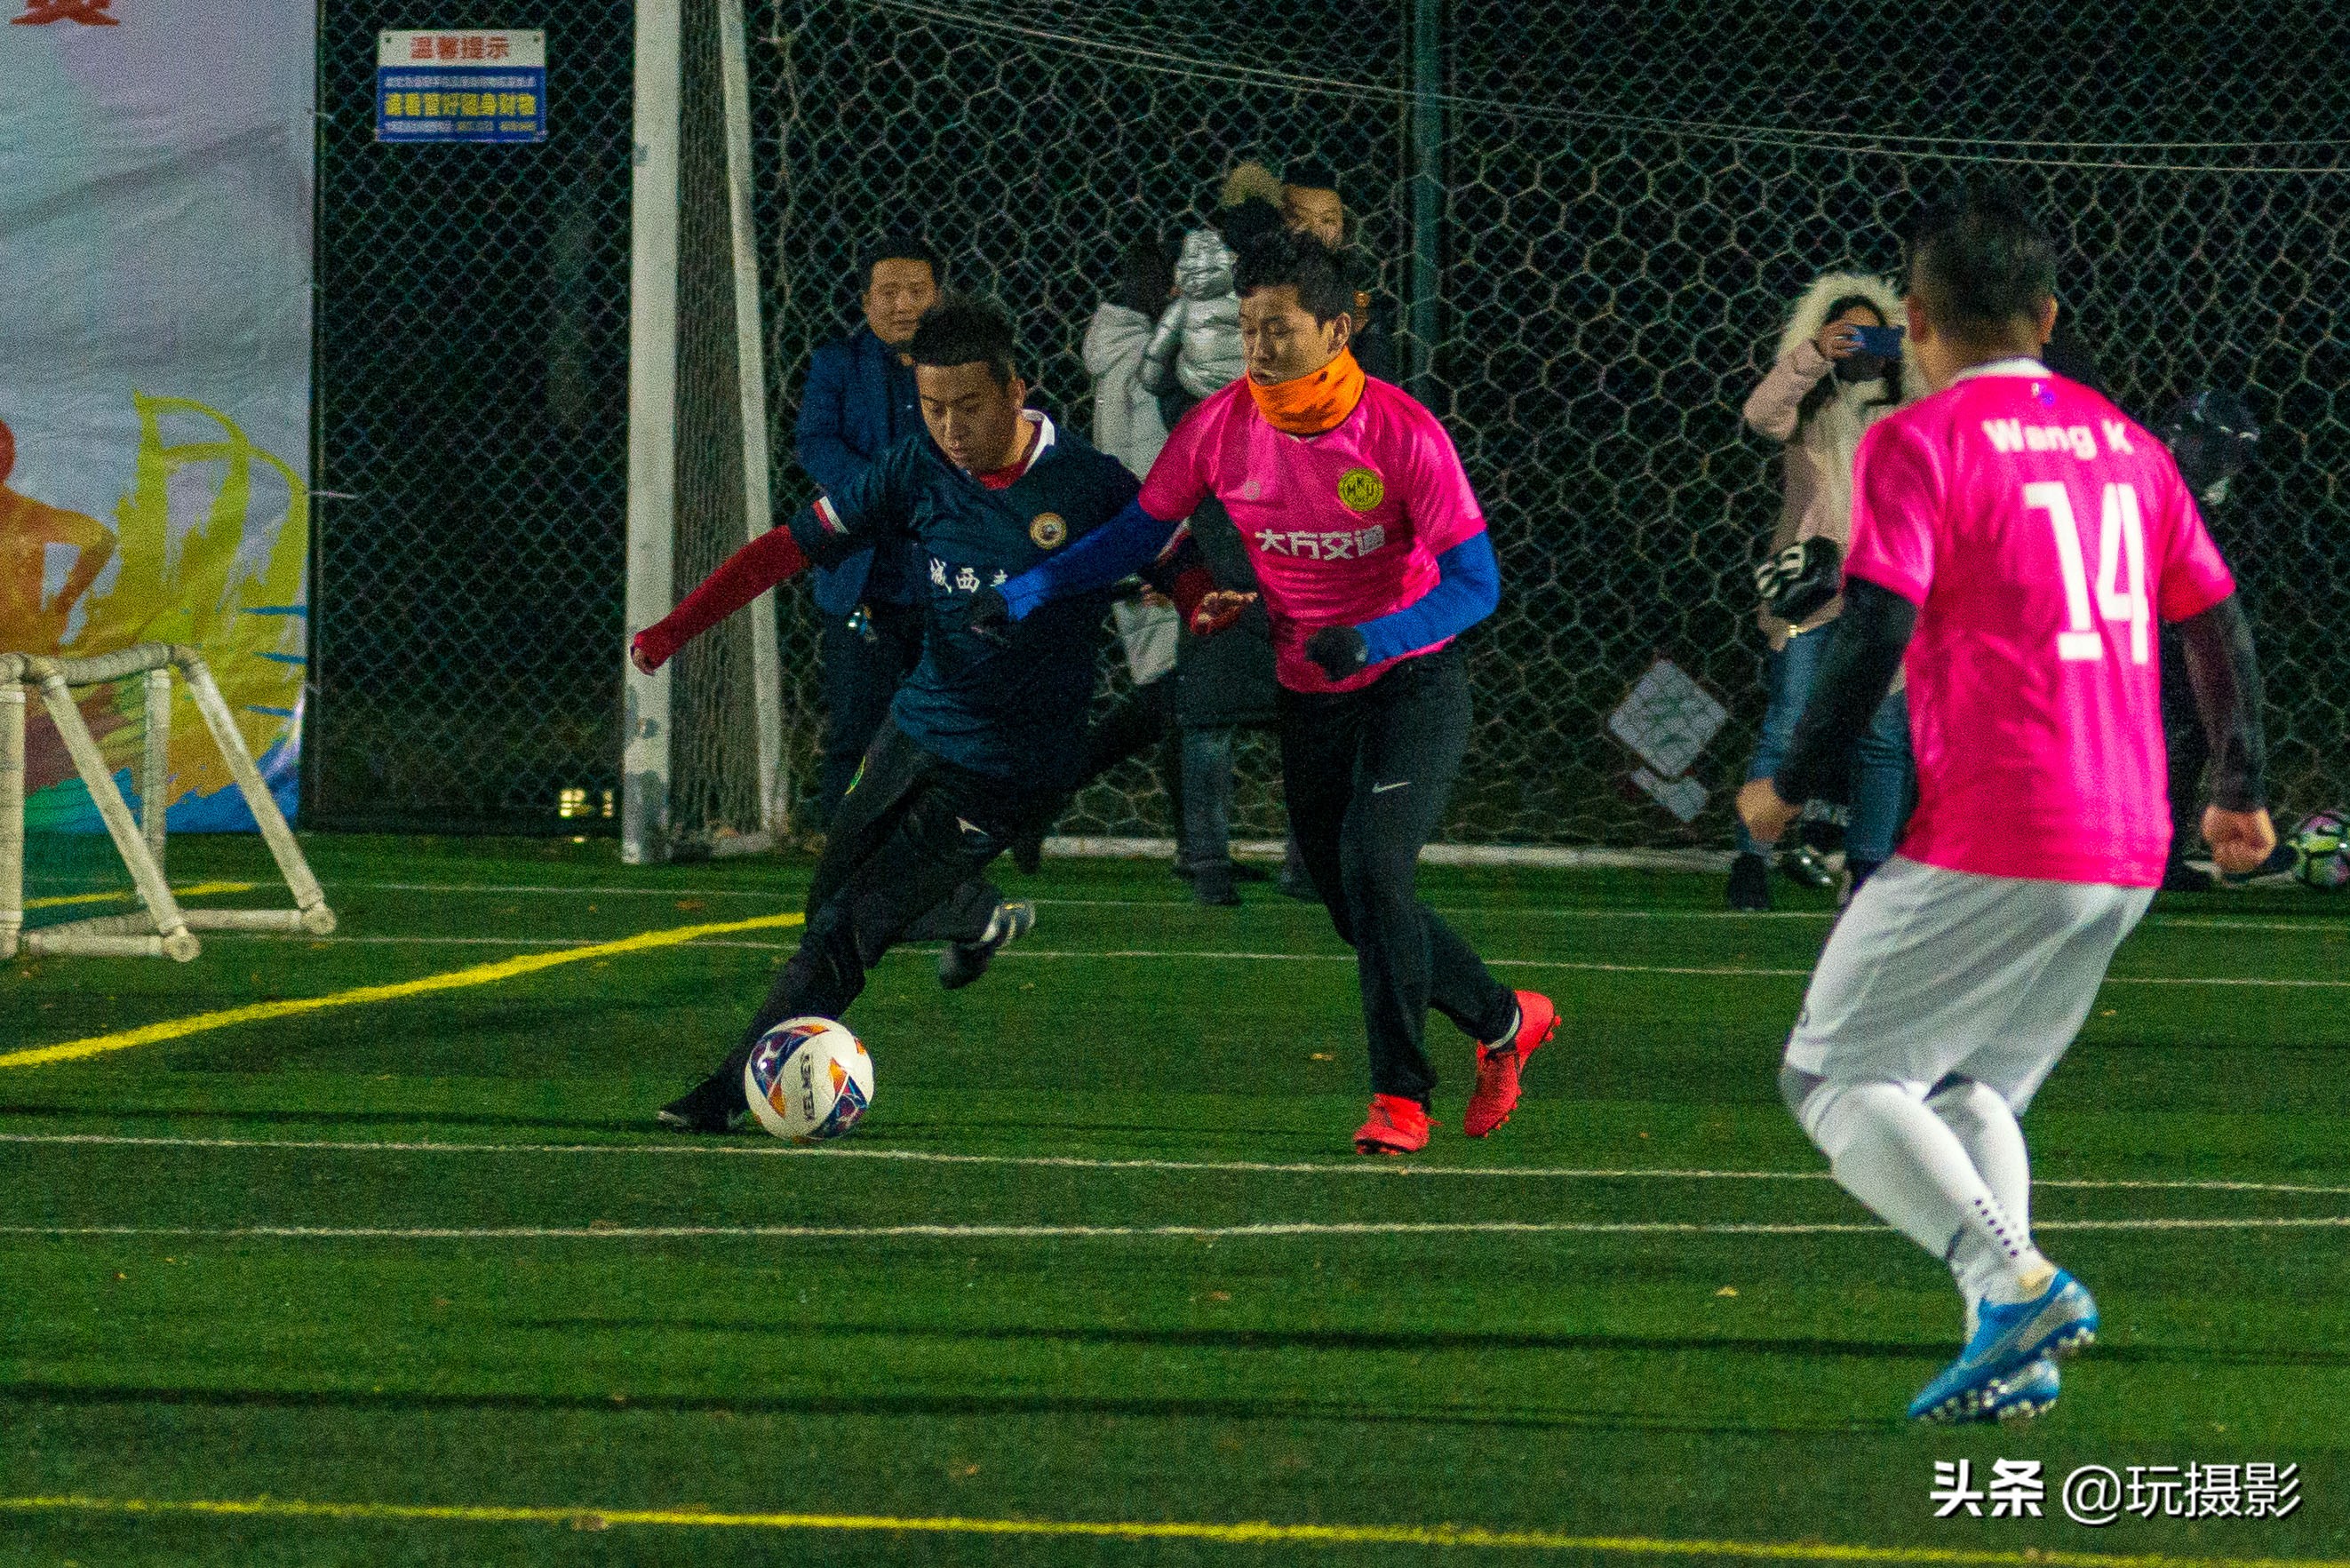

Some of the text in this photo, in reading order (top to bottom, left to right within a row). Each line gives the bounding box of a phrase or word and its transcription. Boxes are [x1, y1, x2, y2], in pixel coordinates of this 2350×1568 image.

[410, 36, 509, 60] 温馨提示
[1981, 418, 2133, 460] Wang K
[1255, 524, 1385, 561] 大方交通
[2024, 482, 2149, 665] 14
